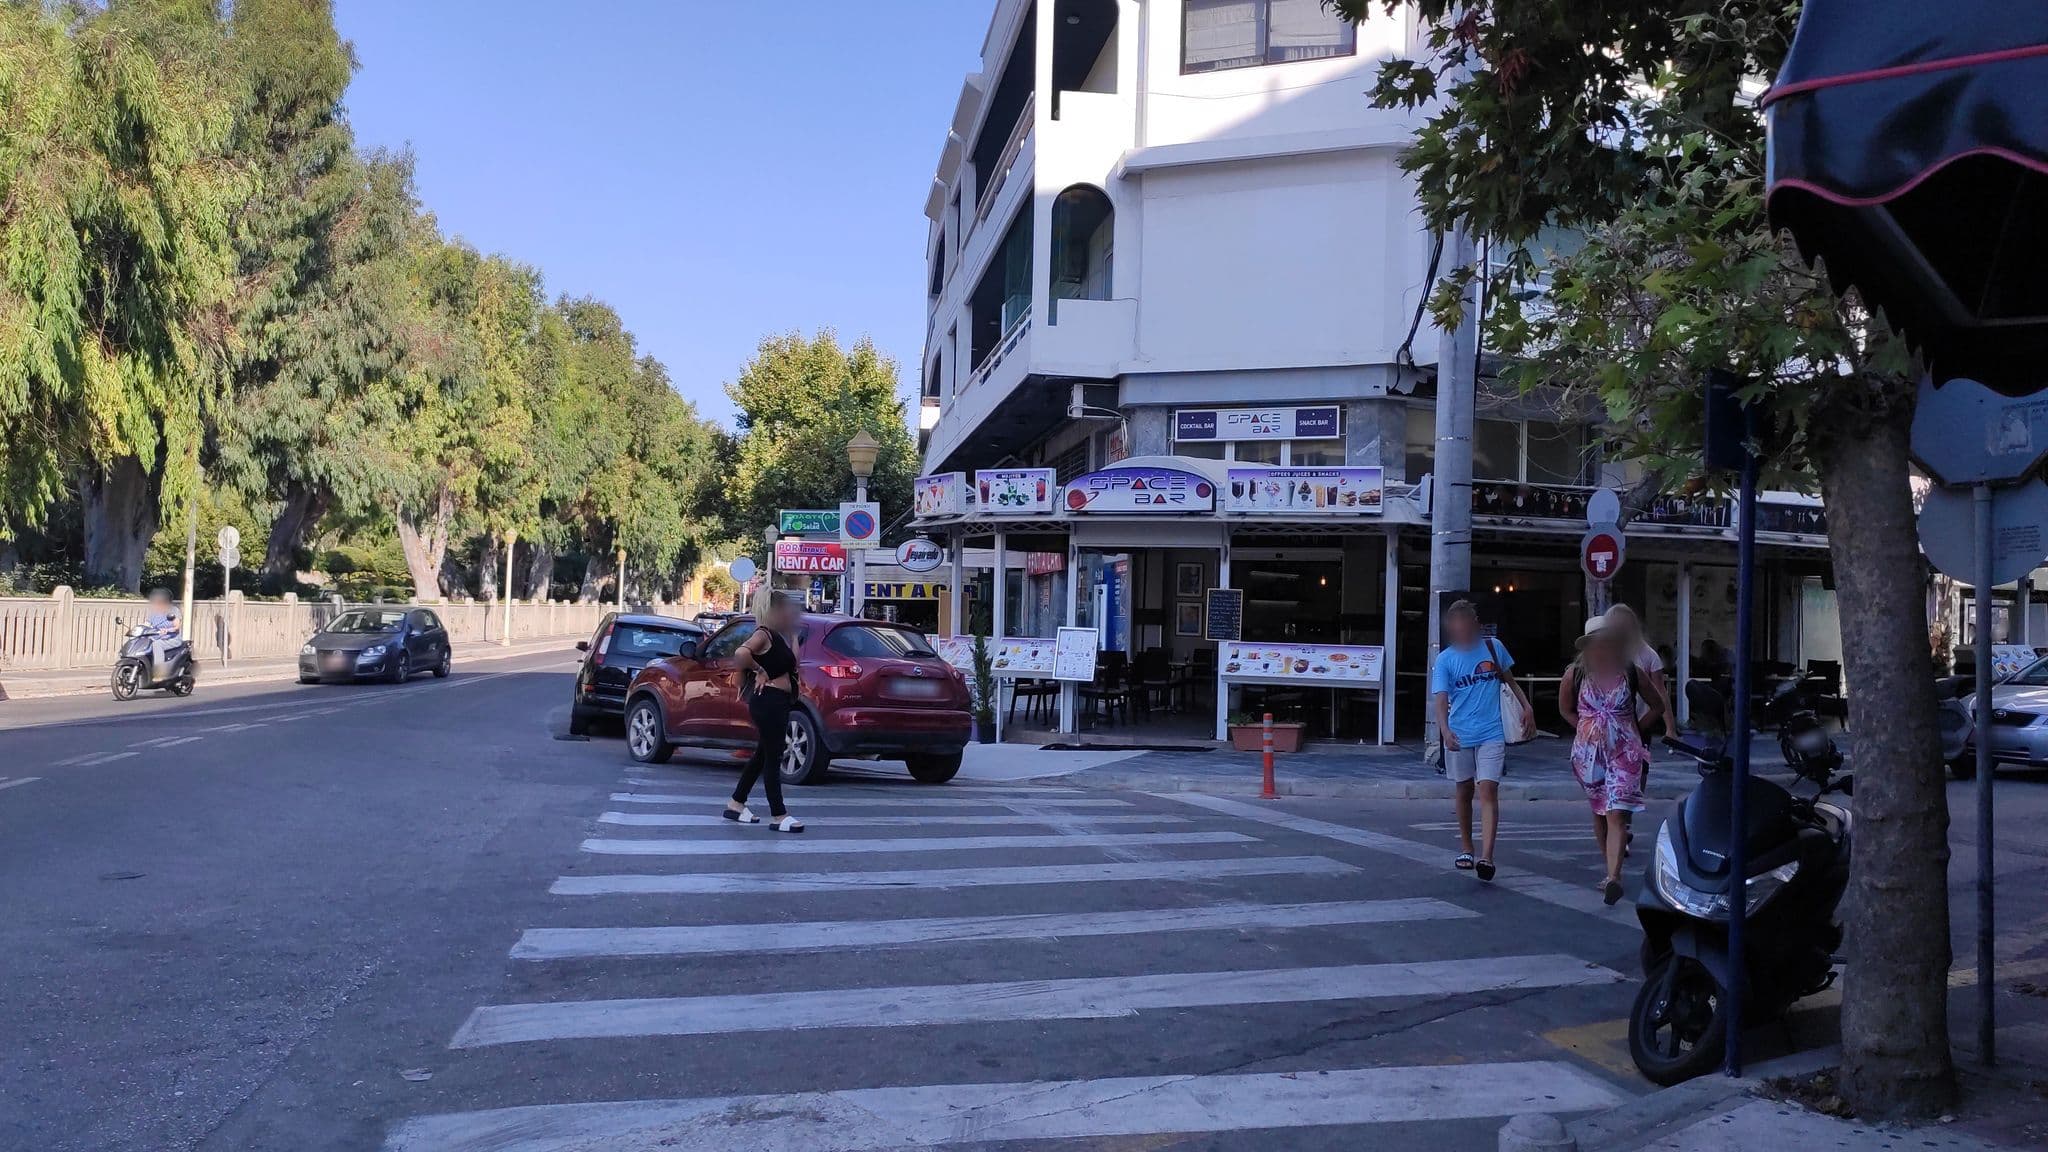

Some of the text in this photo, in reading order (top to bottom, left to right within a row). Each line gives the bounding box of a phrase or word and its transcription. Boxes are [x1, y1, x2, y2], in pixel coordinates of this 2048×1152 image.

[1228, 413, 1281, 424] SPACE
[1252, 424, 1281, 434] BAR
[1089, 477, 1186, 490] SPACE
[1134, 493, 1186, 504] BAR
[778, 556, 845, 571] RENT A CAR
[850, 583, 906, 598] ENT
[910, 583, 926, 598] A
